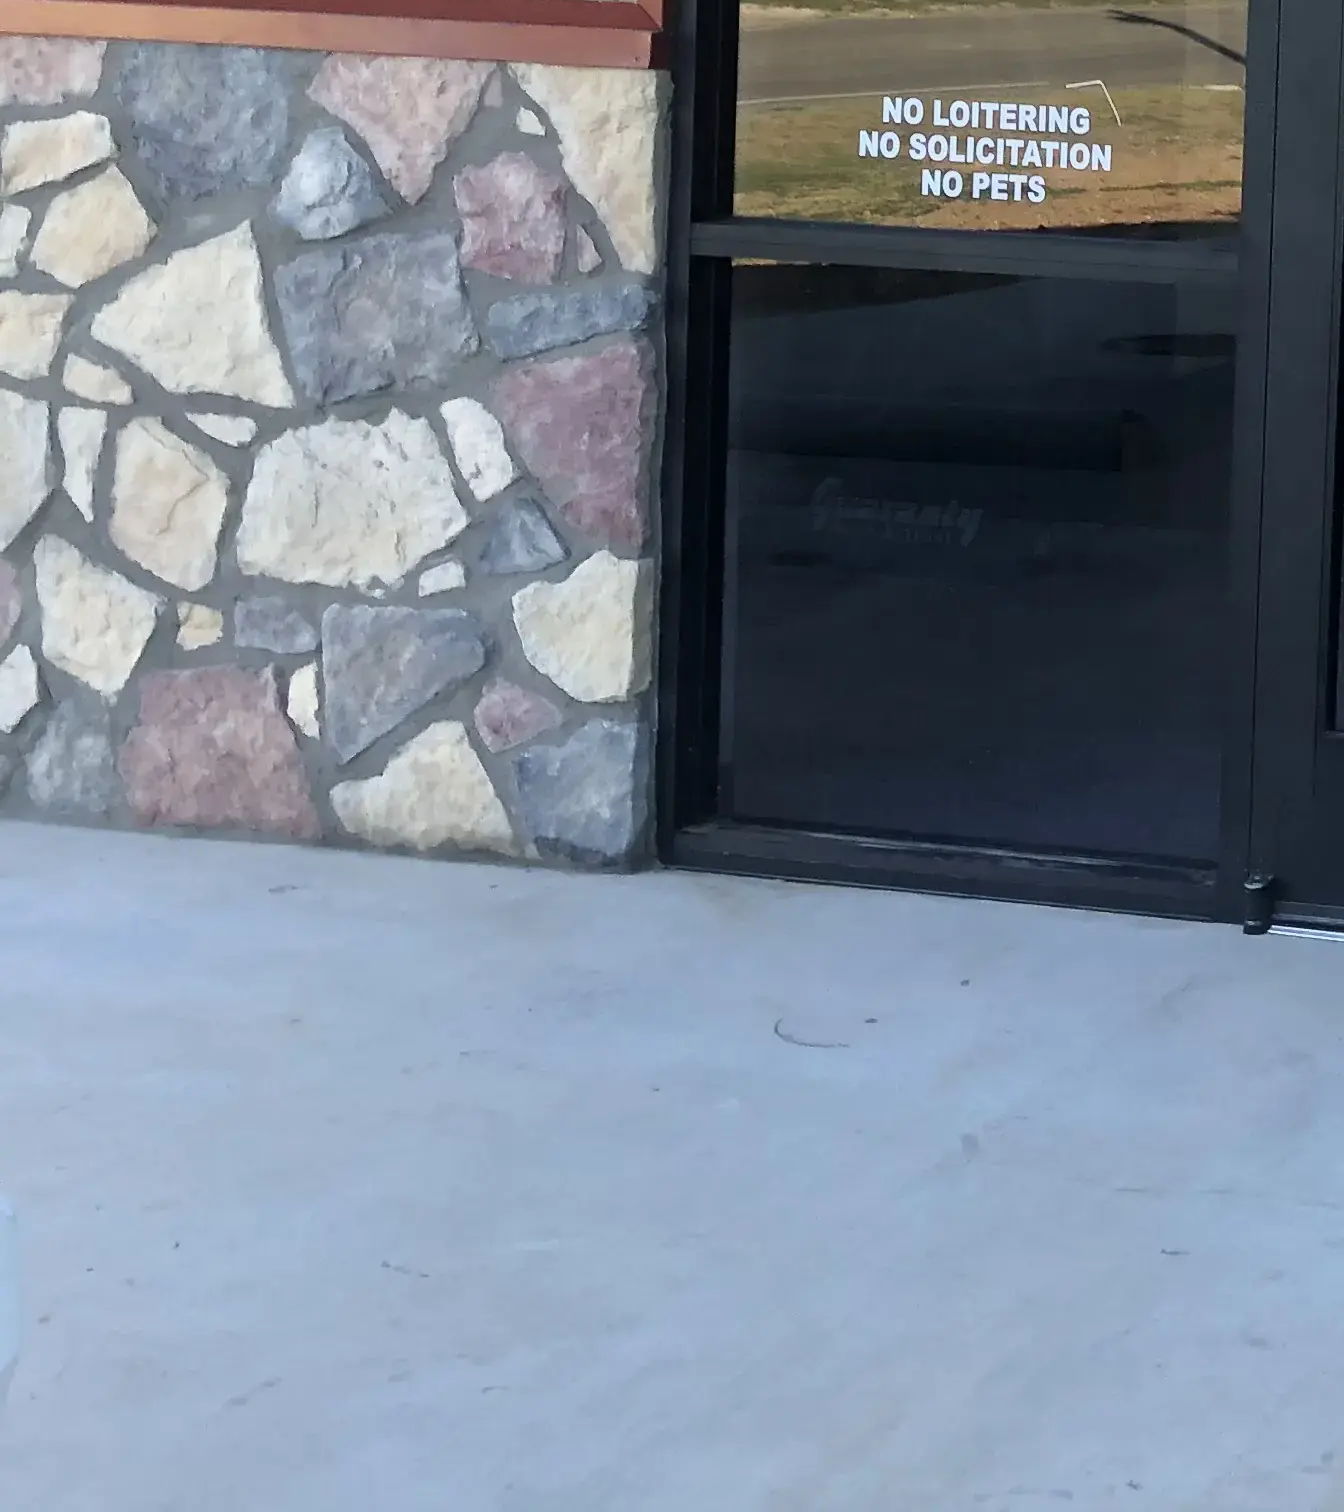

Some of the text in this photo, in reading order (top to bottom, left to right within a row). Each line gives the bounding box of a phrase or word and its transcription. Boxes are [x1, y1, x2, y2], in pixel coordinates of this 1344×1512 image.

[882, 96, 1090, 135] NO LOITERING
[858, 130, 1112, 172] NO SOLICITATION
[921, 169, 1046, 203] NO PETS
